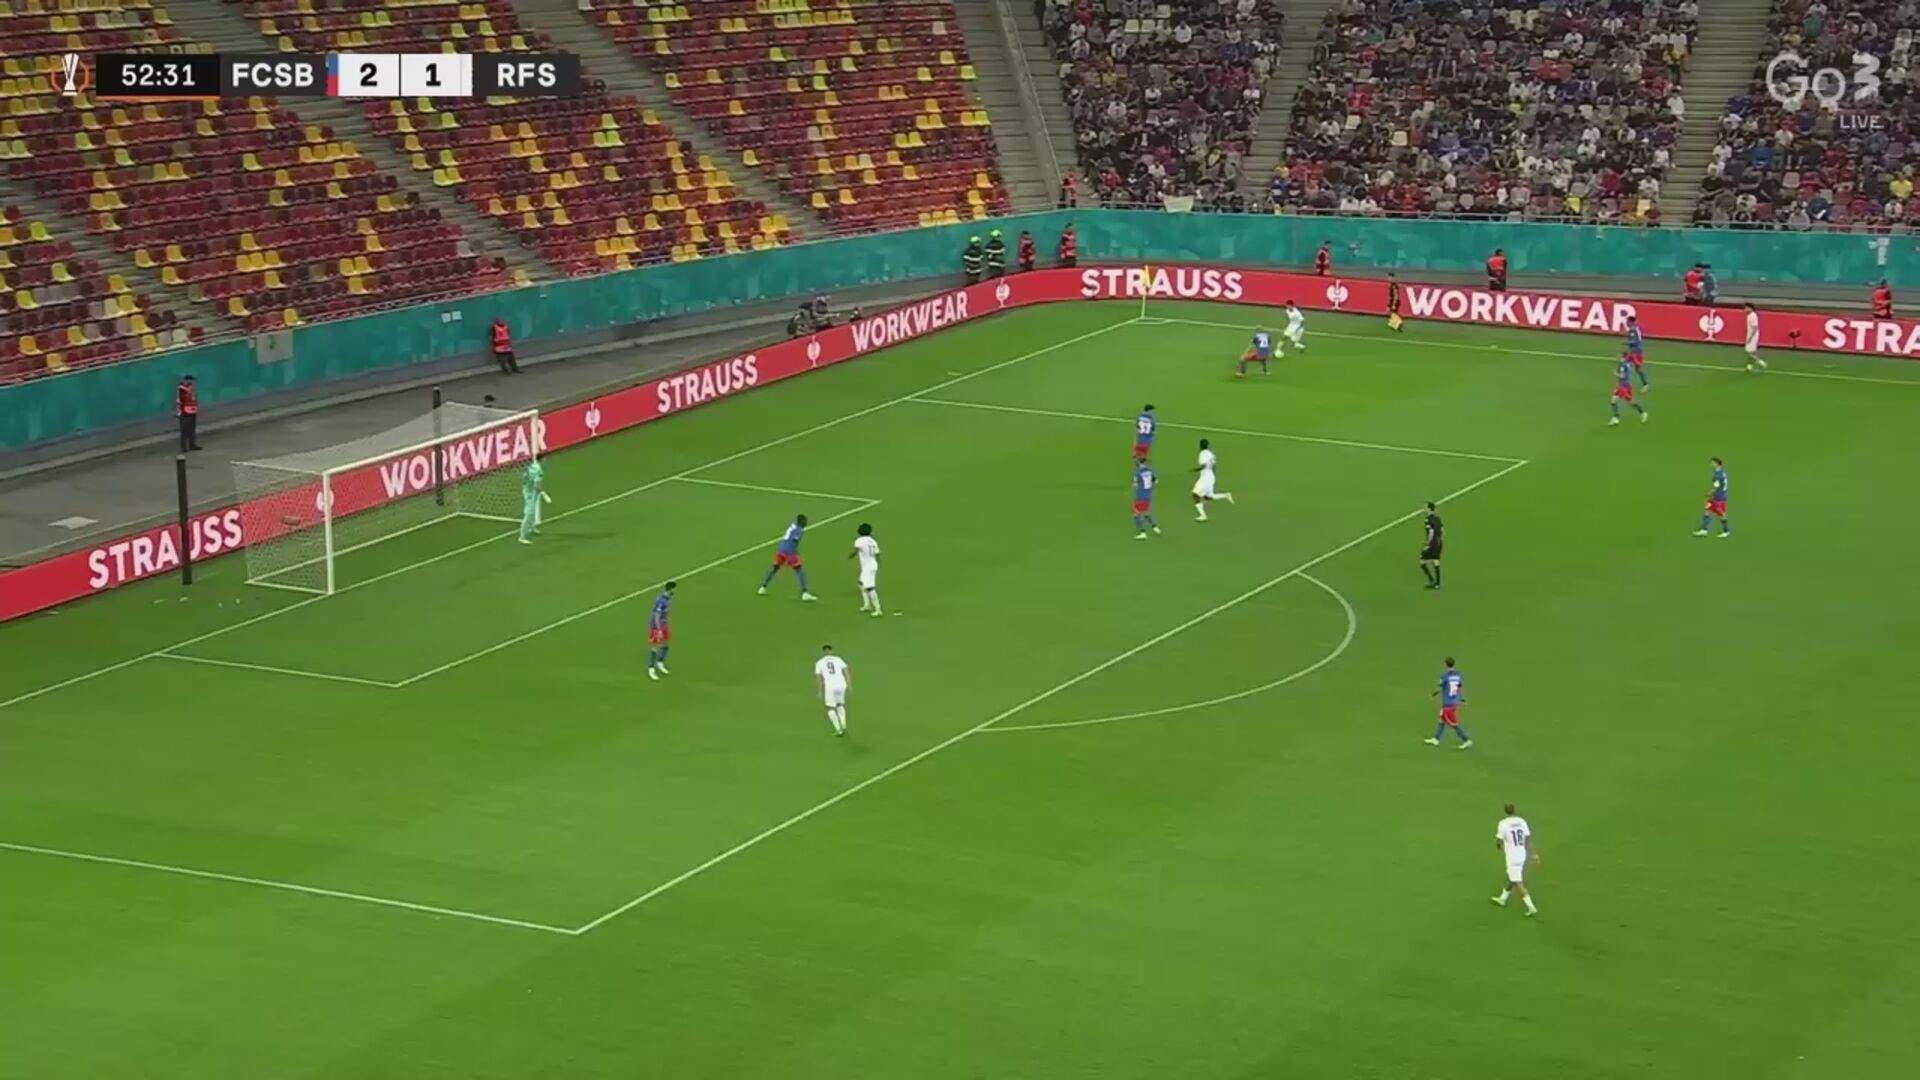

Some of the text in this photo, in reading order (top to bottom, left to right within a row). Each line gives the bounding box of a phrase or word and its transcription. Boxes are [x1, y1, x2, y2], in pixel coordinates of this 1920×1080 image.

[1081, 268, 1243, 300] STRAUSS
[852, 291, 968, 352] WORKWEAR
[1406, 287, 1636, 332] WORKWEAR
[657, 354, 759, 414] STRAUSS
[827, 661, 836, 675] 9
[1511, 829, 1524, 847] 18
